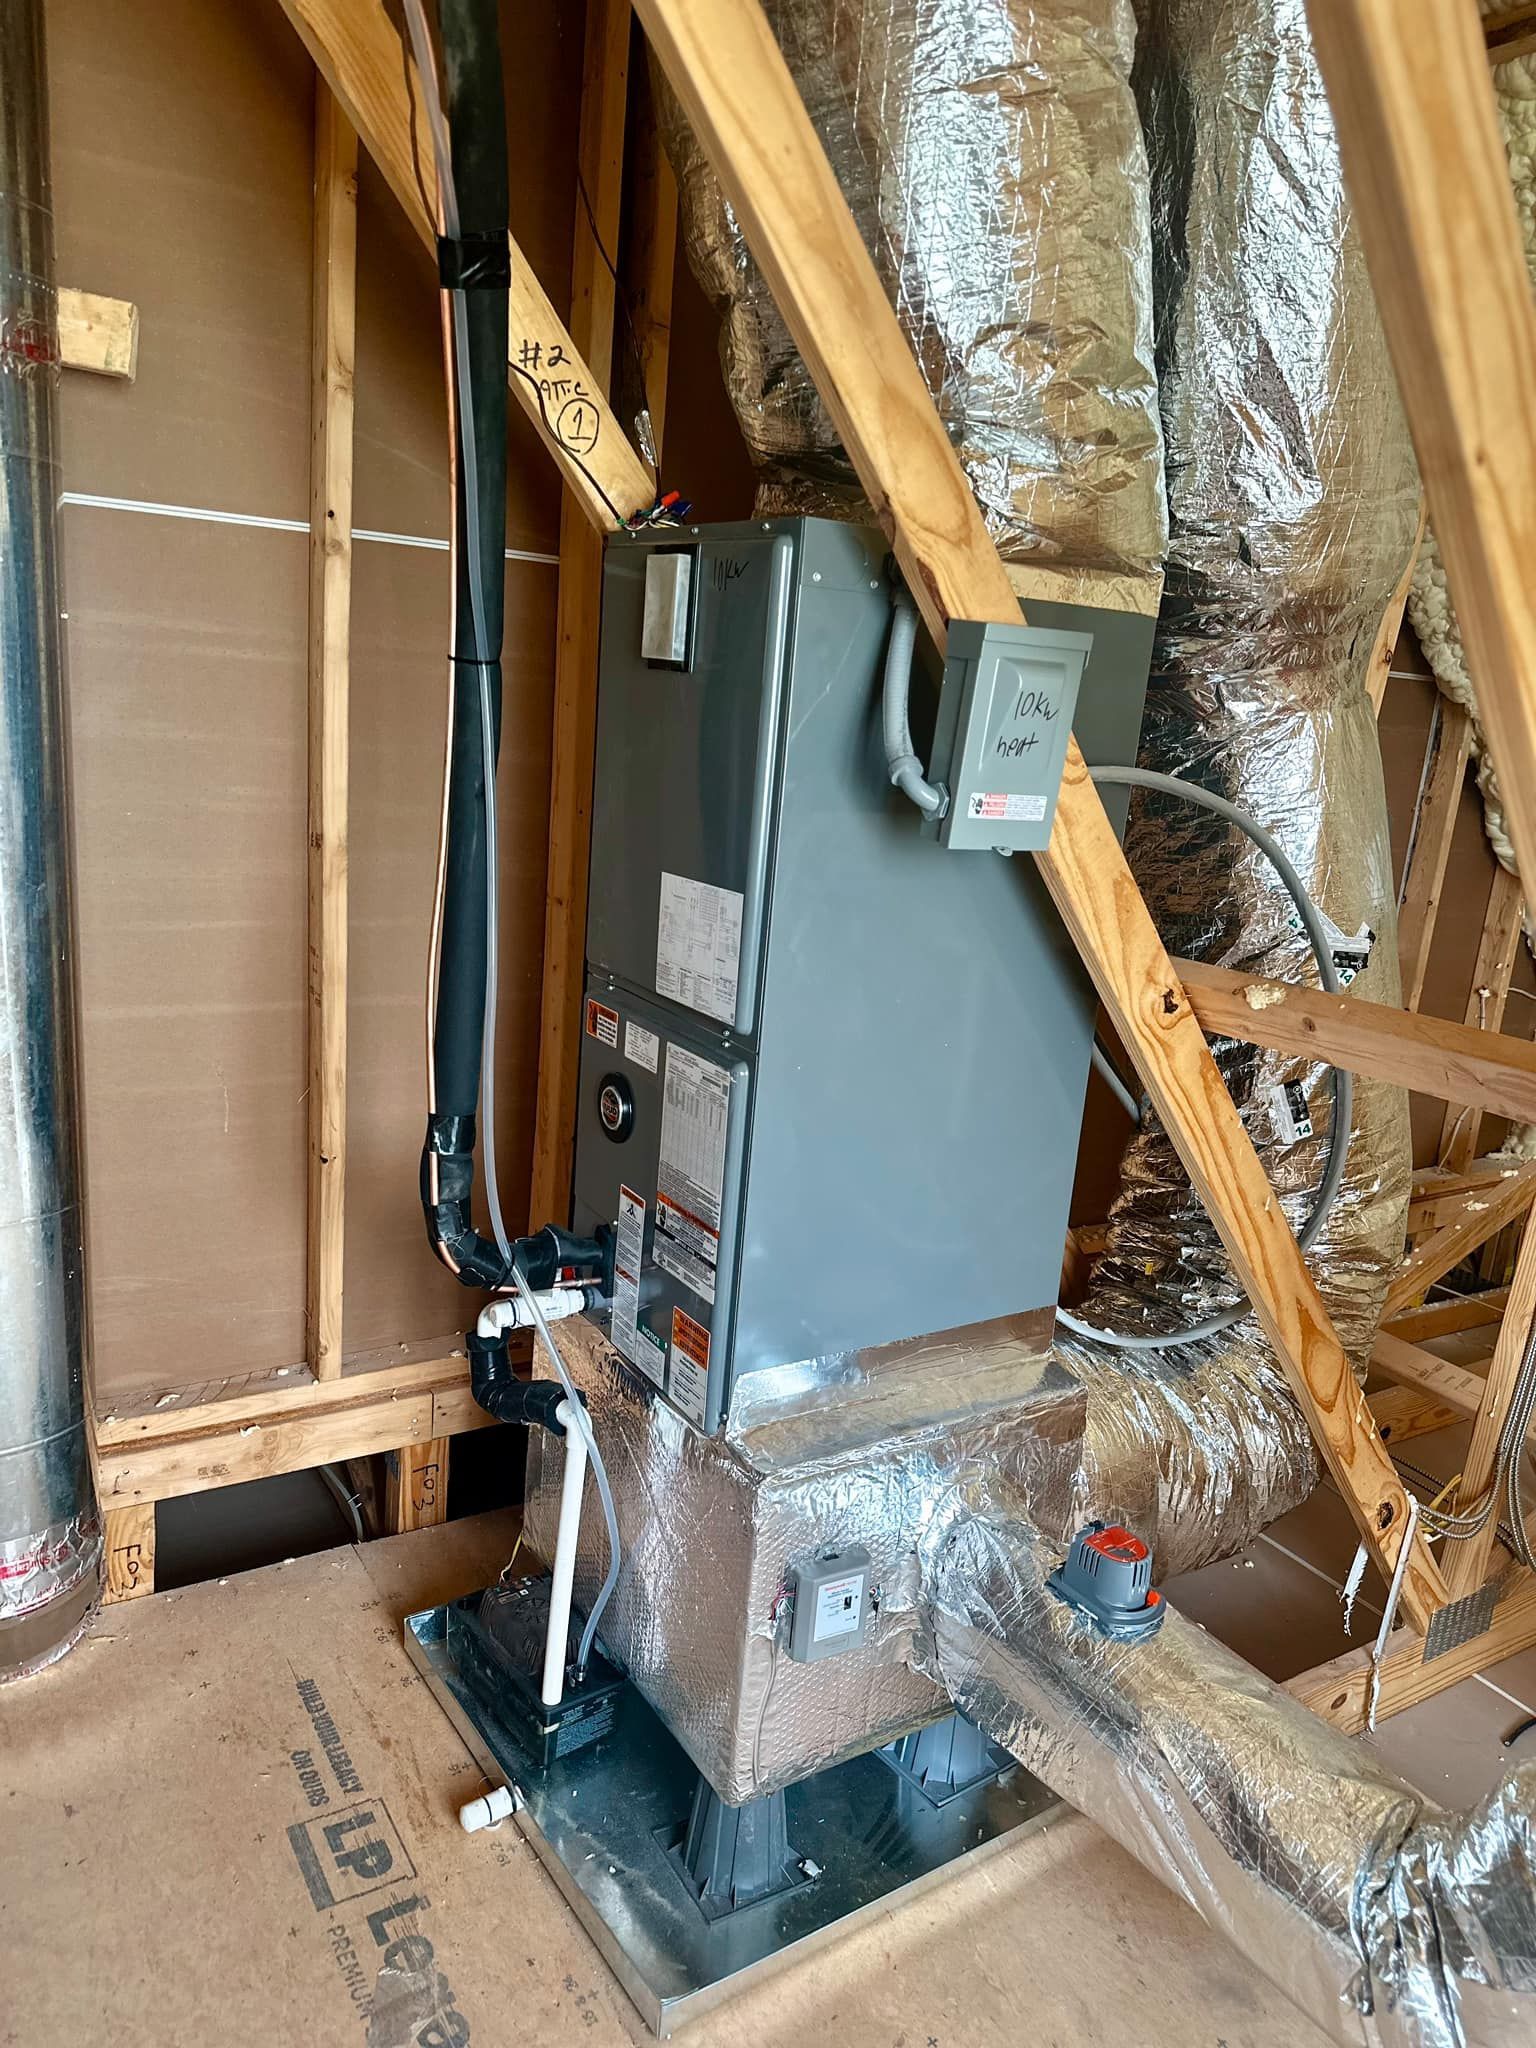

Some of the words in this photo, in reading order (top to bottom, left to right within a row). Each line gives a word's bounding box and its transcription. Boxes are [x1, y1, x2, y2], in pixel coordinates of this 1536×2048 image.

[518, 339, 571, 371] #2
[1338, 968, 1354, 985] 14
[1295, 1123, 1312, 1137] 14
[641, 1324, 661, 1347] NOTICE
[311, 1711, 342, 1749] YOUR
[290, 1749, 315, 1770] ON
[326, 1743, 364, 1795] LEGACY
[299, 1768, 331, 1807] OURS
[323, 1811, 393, 1879] LP
[327, 1923, 375, 2021] PREMIUM
